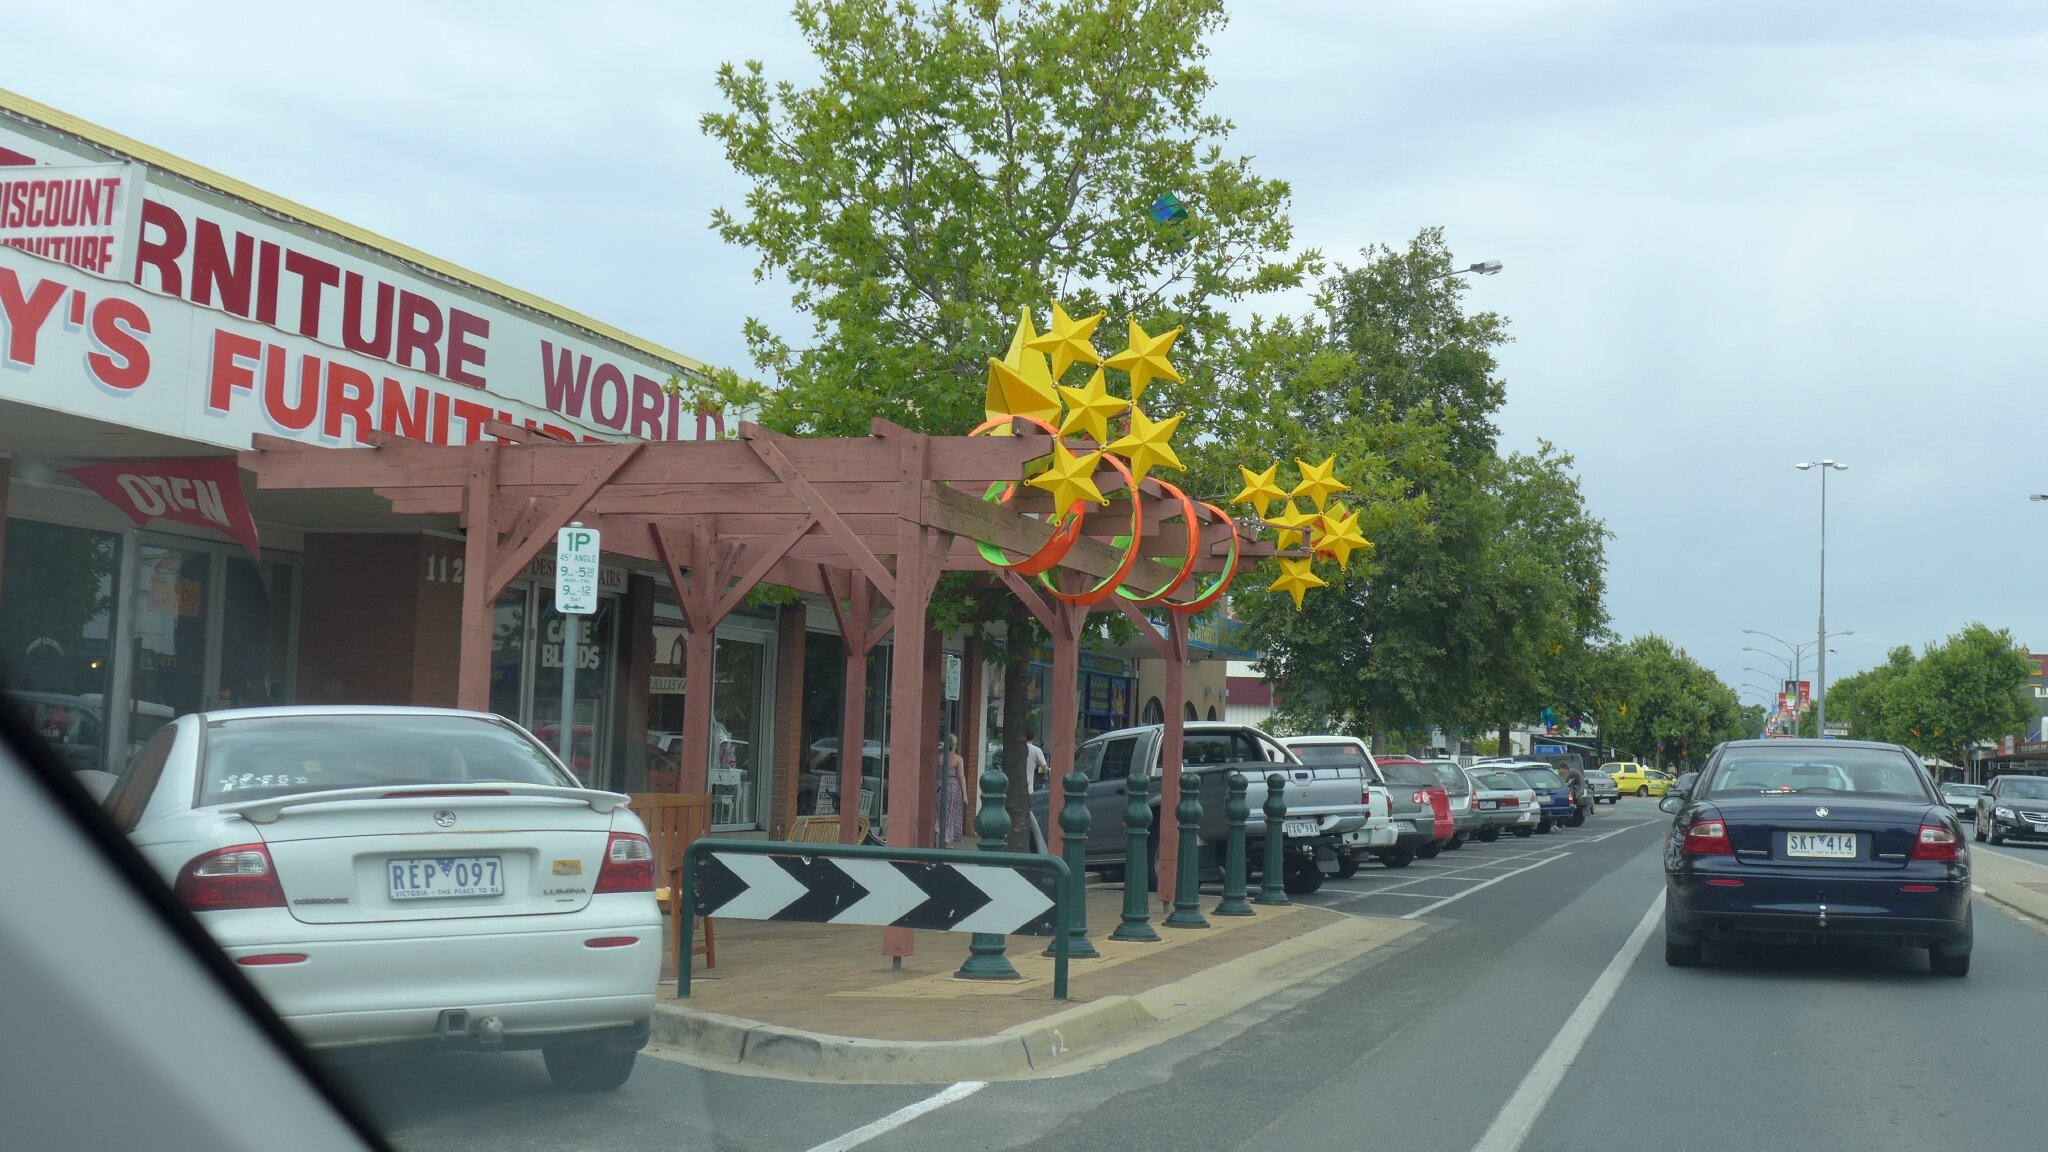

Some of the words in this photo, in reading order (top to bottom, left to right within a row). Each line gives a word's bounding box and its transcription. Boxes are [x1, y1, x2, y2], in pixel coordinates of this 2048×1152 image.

[0, 178, 121, 229] ISCOUNT
[209, 328, 613, 444] FURNIT
[567, 532, 591, 552] 1P
[426, 554, 463, 584] 112
[575, 555, 596, 563] ANGLE
[599, 569, 622, 588] AIRS
[541, 644, 600, 670] BLDS
[1791, 835, 1815, 850] SKT
[1827, 836, 1852, 851] 414
[393, 864, 436, 889] REP
[456, 862, 497, 887] 097
[396, 889, 428, 897] VICTORIA
